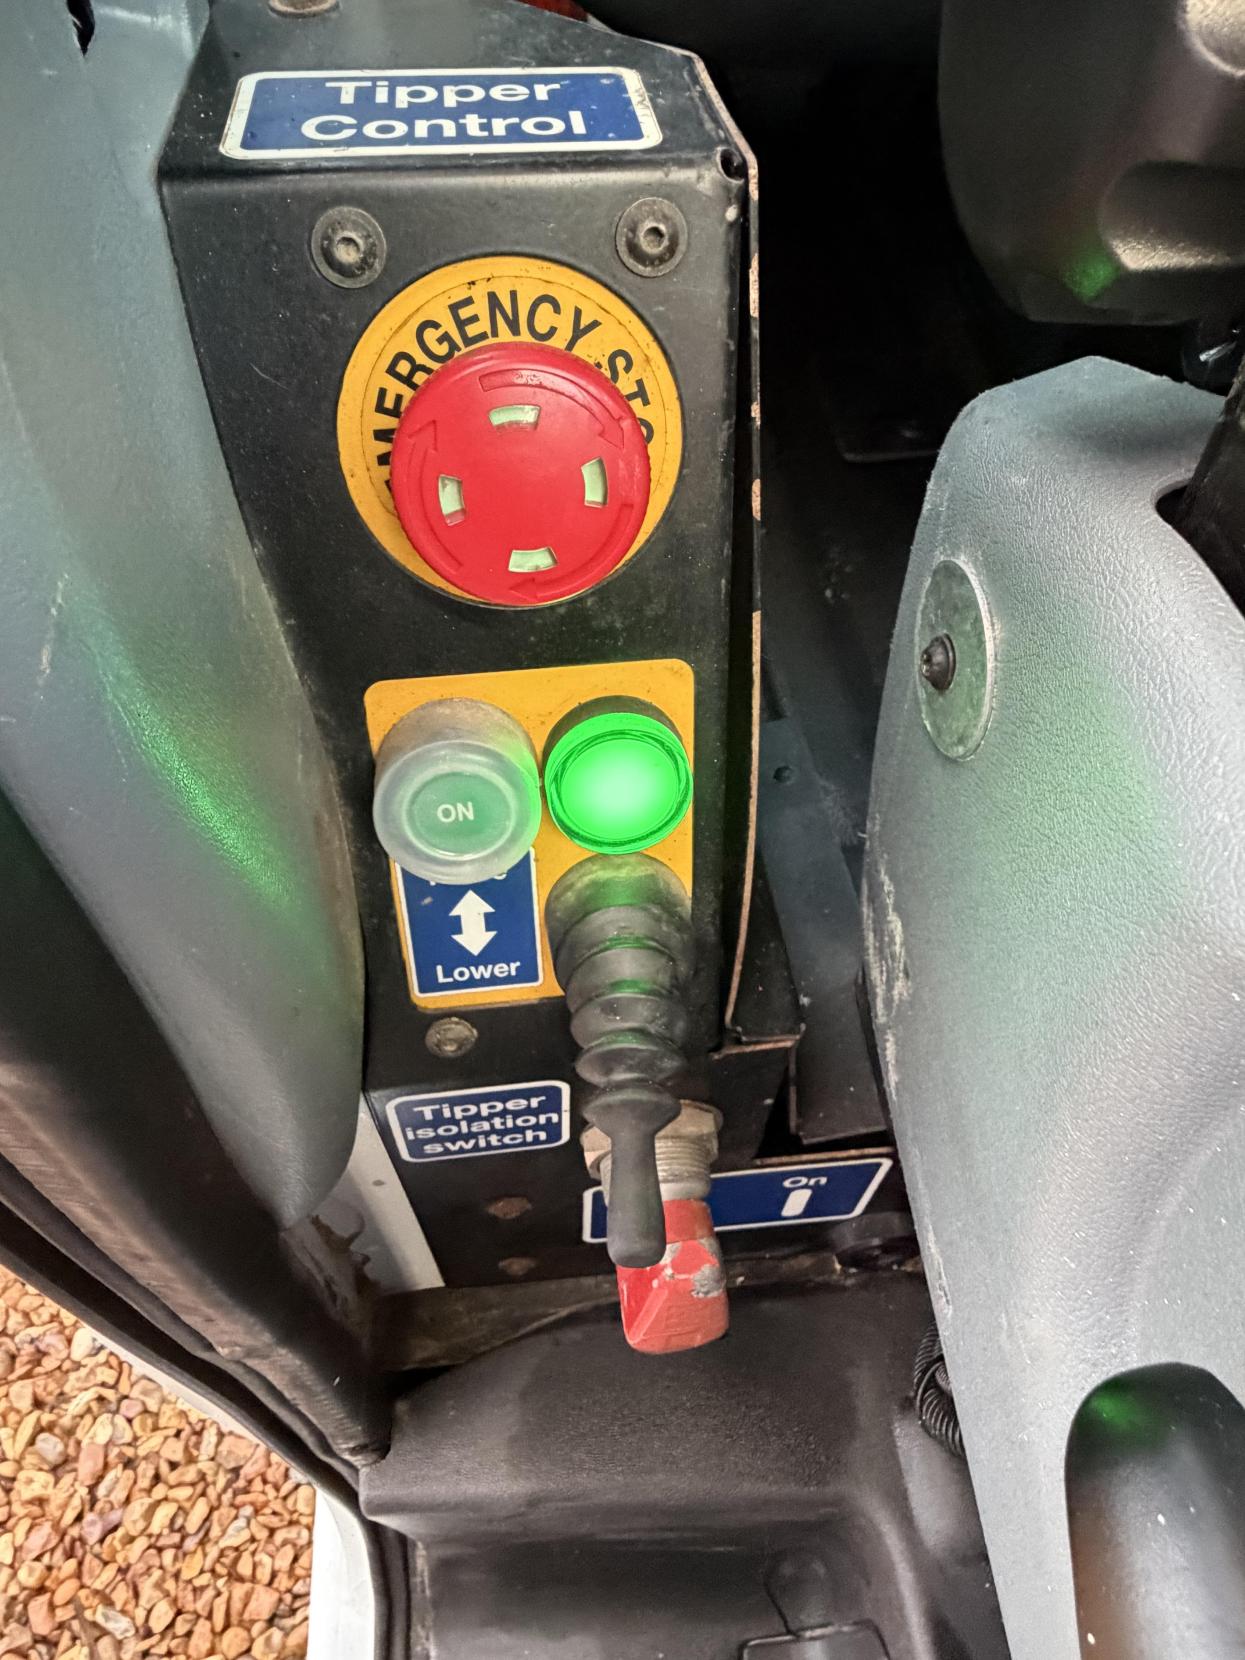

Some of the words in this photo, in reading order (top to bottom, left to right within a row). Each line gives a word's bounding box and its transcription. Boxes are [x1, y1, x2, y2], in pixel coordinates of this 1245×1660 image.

[325, 80, 561, 108] Tipper
[300, 110, 587, 140] Control
[372, 289, 602, 492] ERGENCY
[436, 801, 475, 823] ON
[436, 959, 521, 983] Lower
[412, 1095, 547, 1121] Tipper
[405, 1112, 560, 1140] isolation
[422, 1129, 548, 1153] switch
[782, 1176, 828, 1188] On
